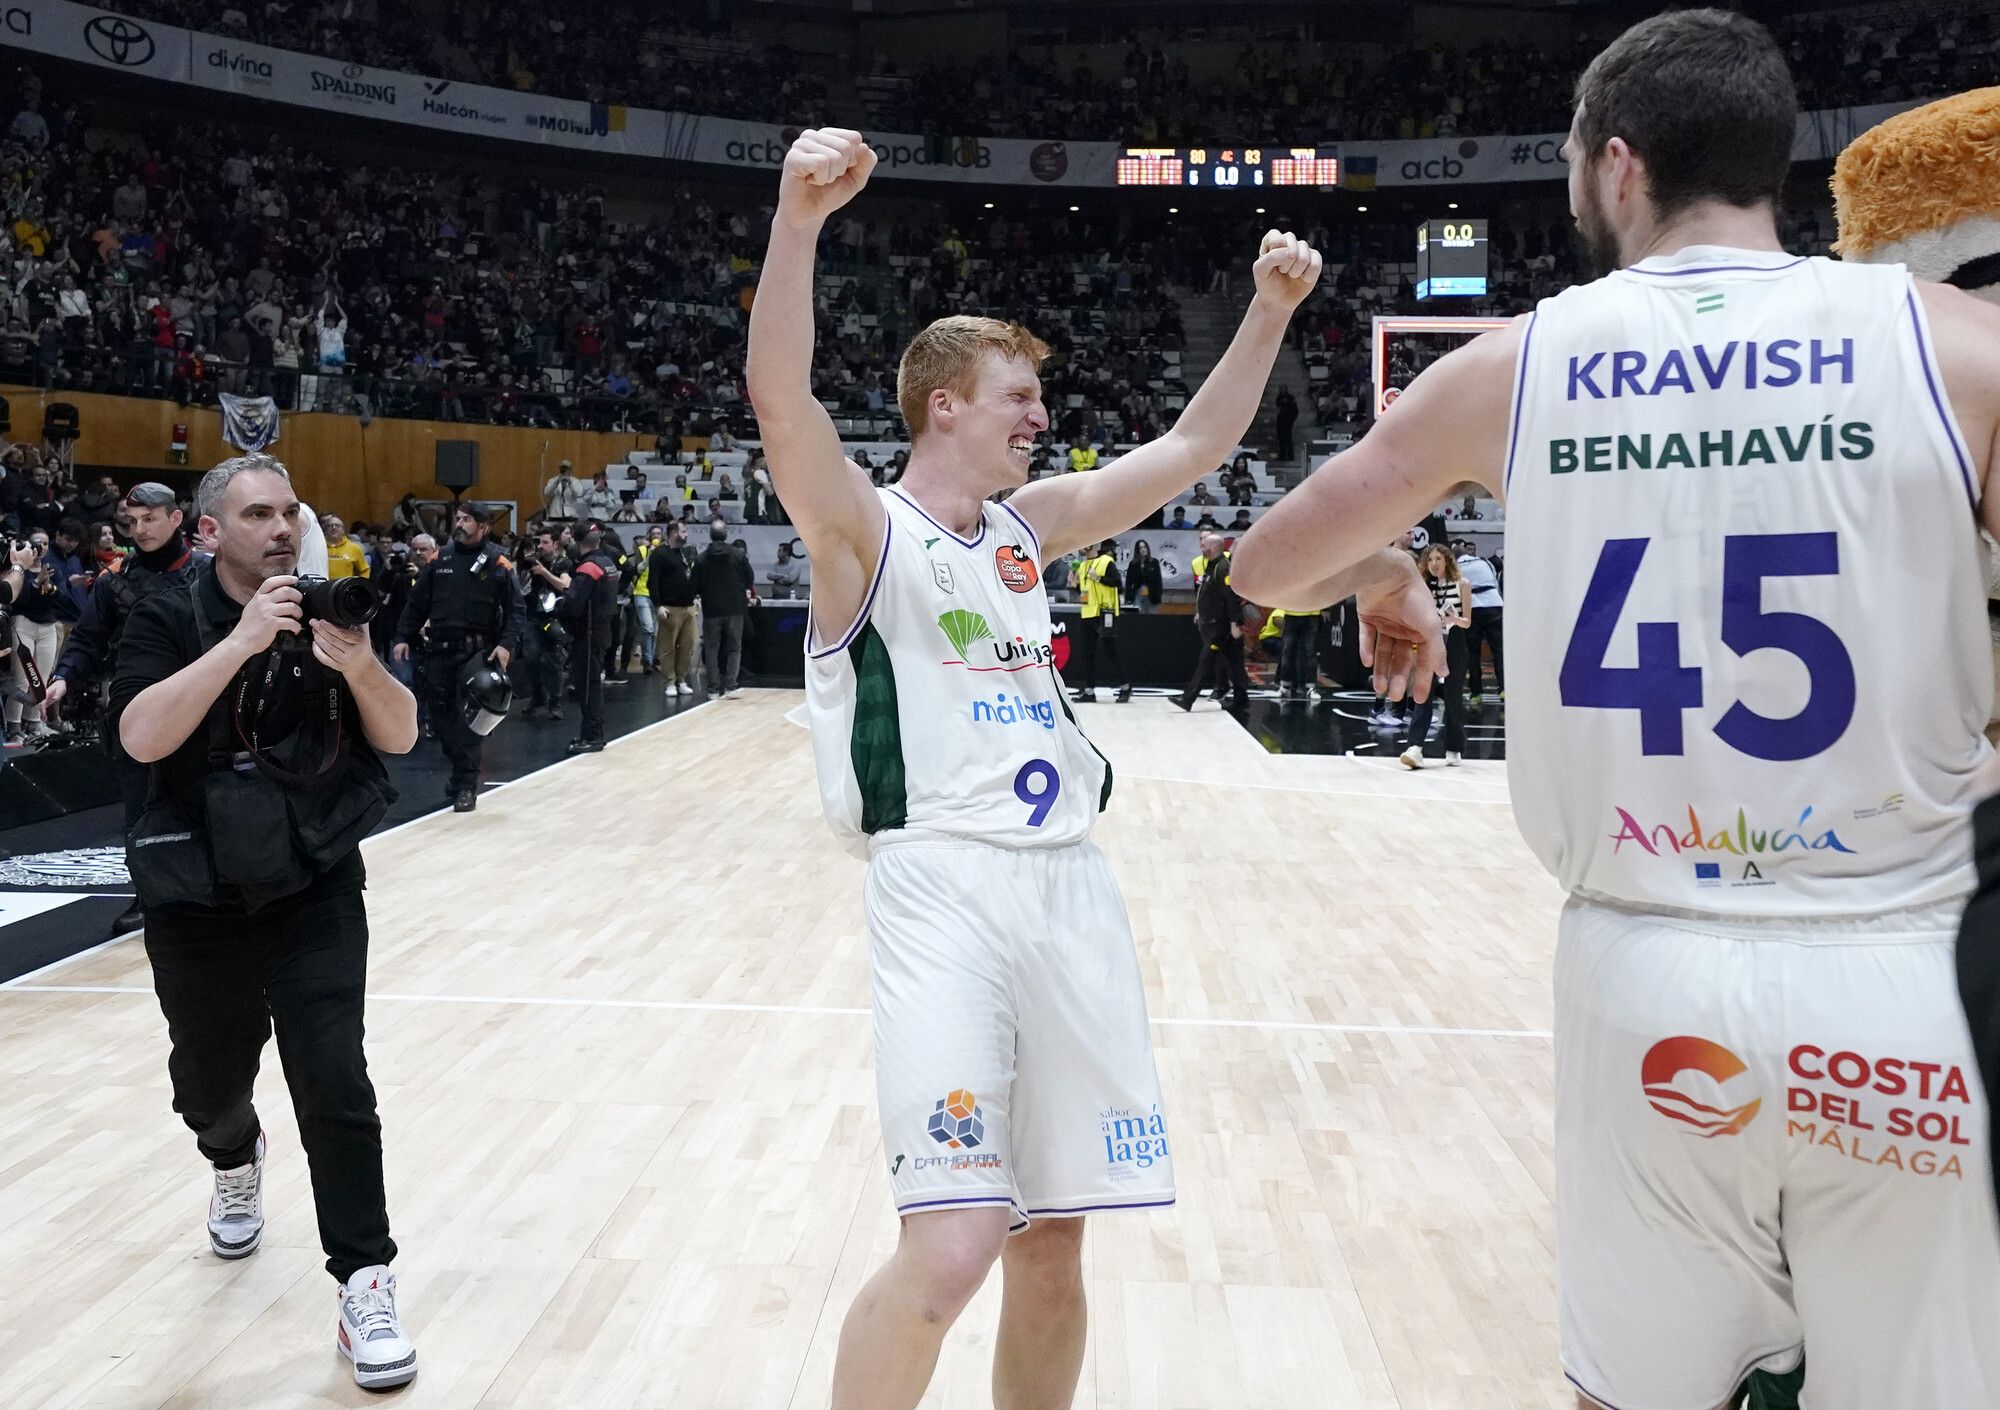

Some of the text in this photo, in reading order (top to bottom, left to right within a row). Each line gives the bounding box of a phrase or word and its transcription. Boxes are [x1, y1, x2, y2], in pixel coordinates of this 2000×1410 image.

[208, 50, 272, 78] divina
[310, 71, 396, 105] SPALDING
[423, 99, 479, 121] Halcón
[1190, 149, 1206, 165] 80
[1244, 149, 1261, 165] 83
[1401, 156, 1463, 180] acb
[1215, 166, 1239, 186] 0.0
[1443, 224, 1473, 241] 0.0
[1567, 338, 1854, 401] KRAVISH
[1549, 415, 1875, 474] BENAHAVÍS
[1002, 564, 1021, 573] Copa
[1012, 573, 1027, 581] Rey
[1559, 531, 1856, 762] 45
[25, 661, 40, 688] Canon
[1013, 758, 1061, 828] 9
[1609, 804, 1857, 857] Andalucía
[1788, 1044, 1970, 1104] COSTA
[1113, 1104, 1165, 1140] má
[1788, 1087, 1970, 1146] DEL SOL
[1105, 1135, 1169, 1168] laga
[1788, 1120, 1963, 1181] MÁLAGA
